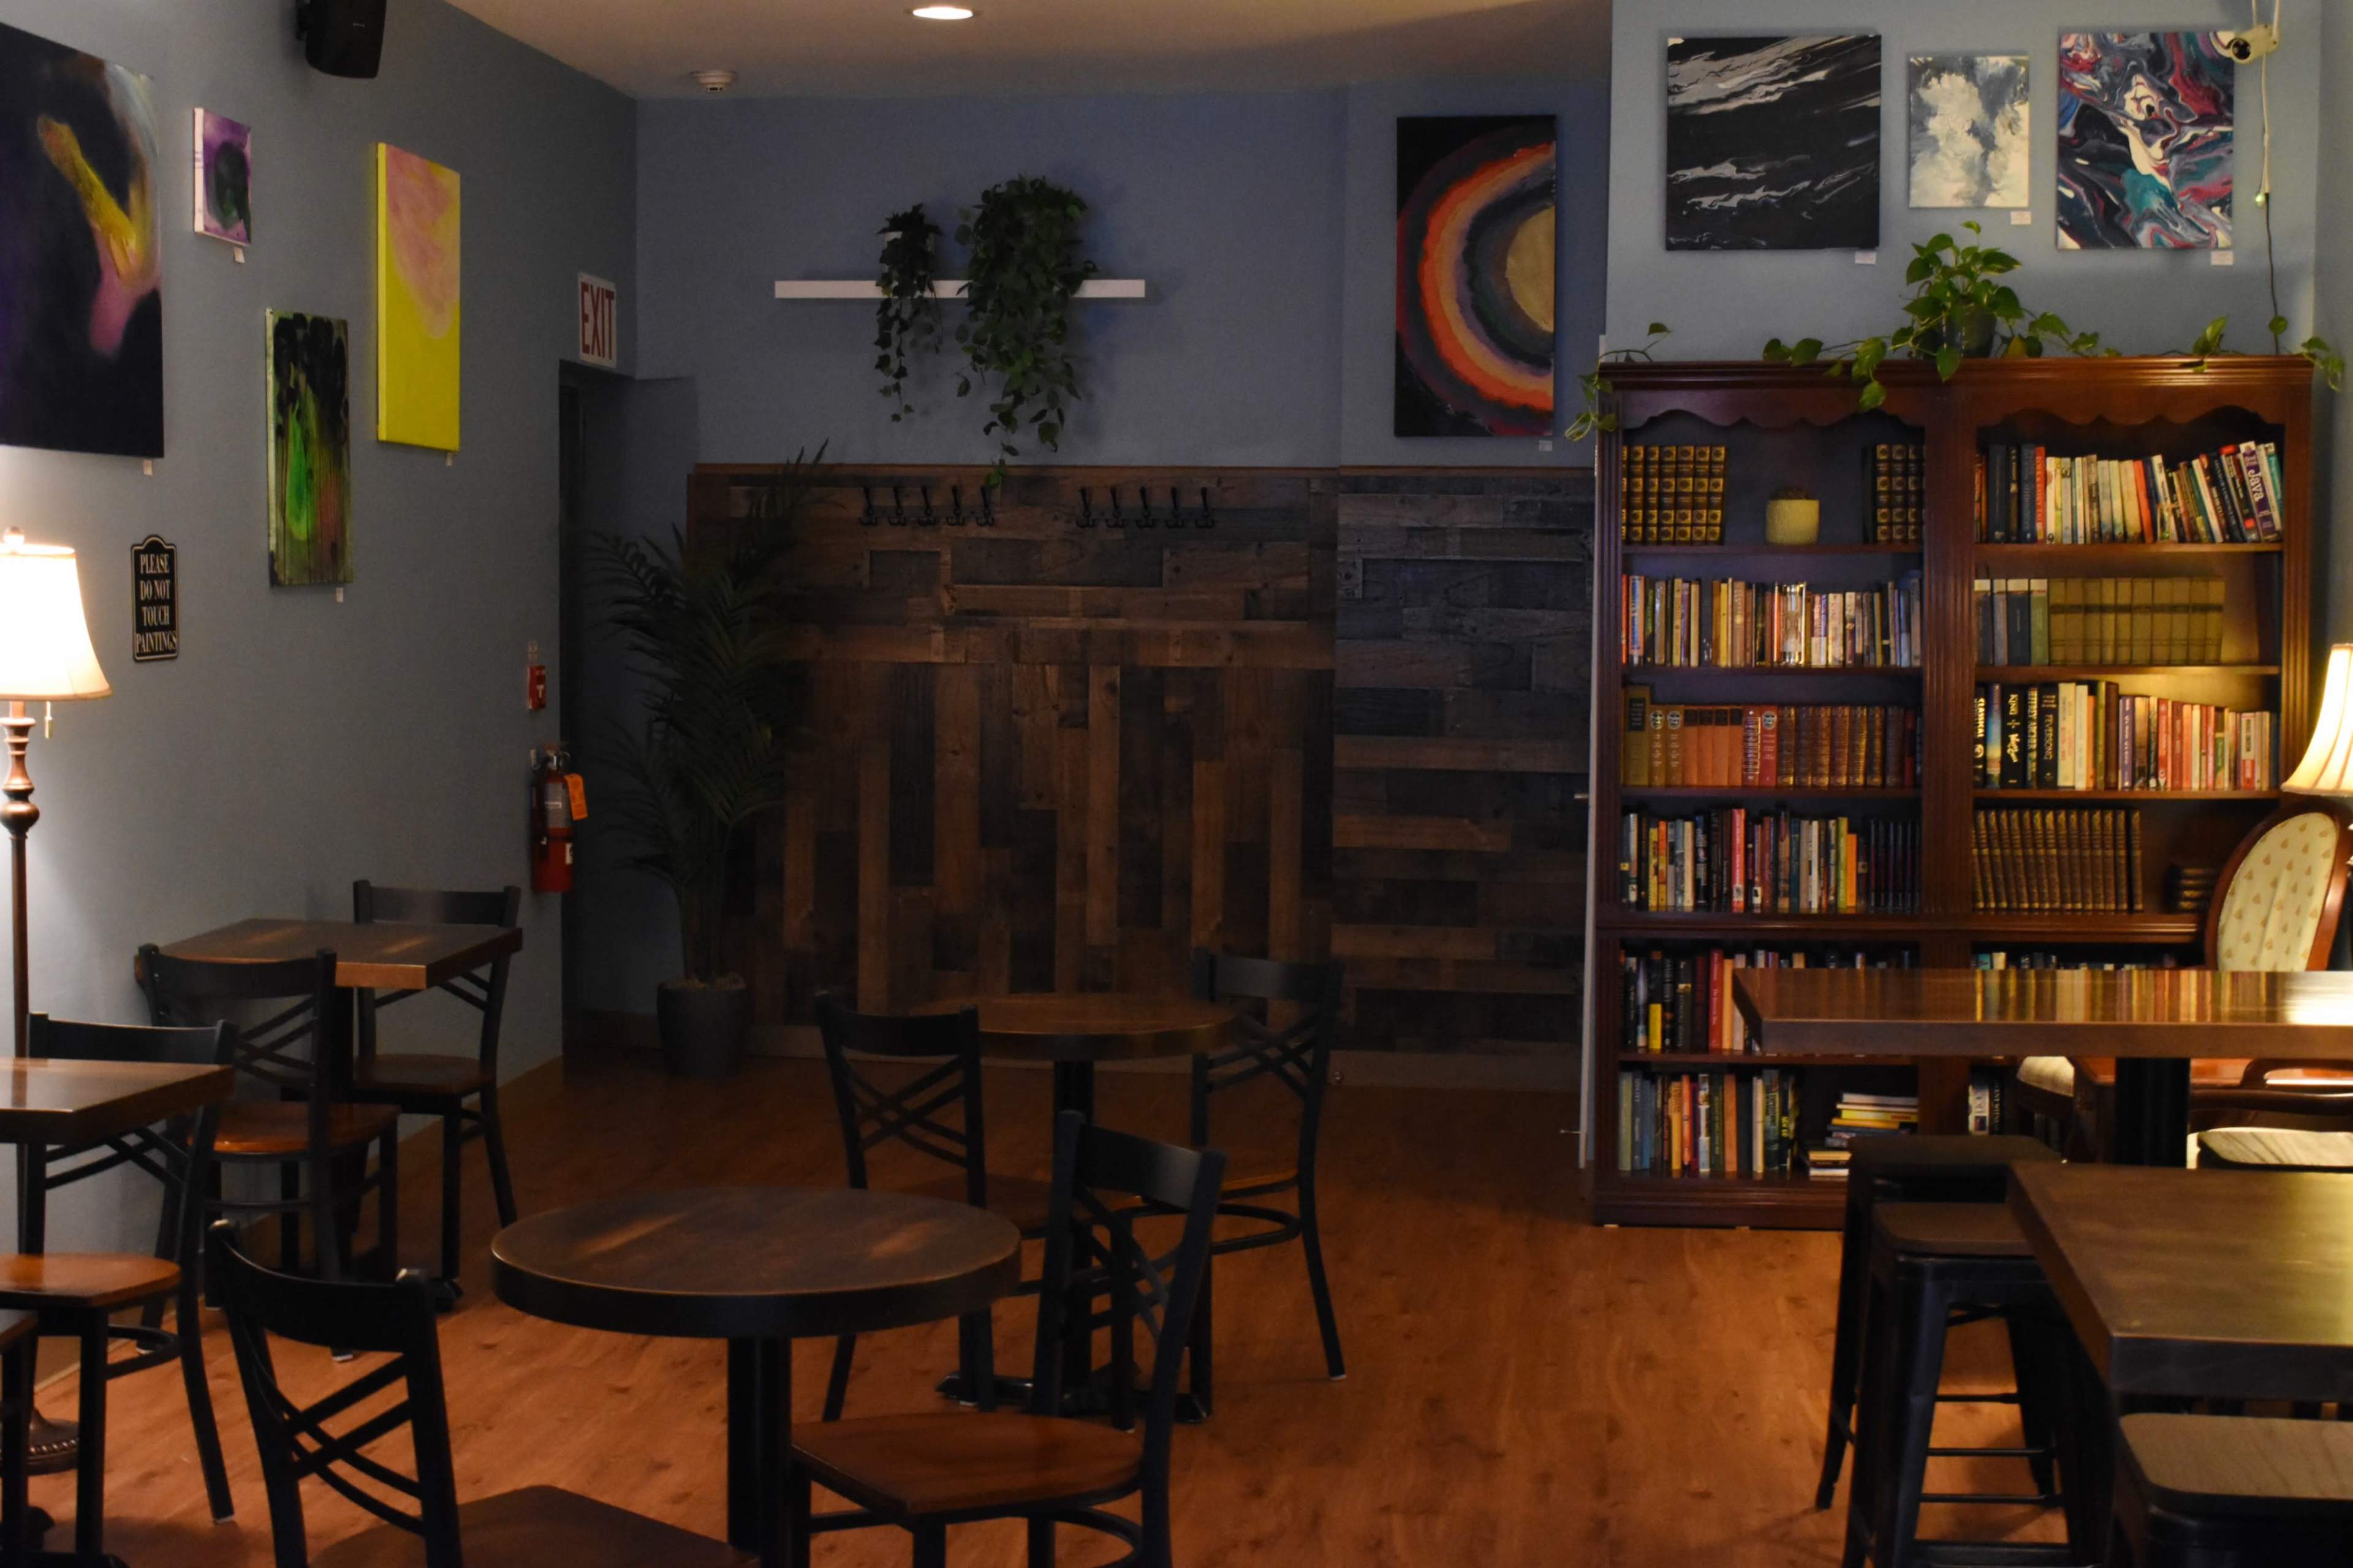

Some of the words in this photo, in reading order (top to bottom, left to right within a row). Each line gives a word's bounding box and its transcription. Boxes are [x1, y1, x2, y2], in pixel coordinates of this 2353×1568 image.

[581, 282, 614, 360] EXIT
[2248, 469, 2264, 502] Java
[140, 554, 169, 574] PLEASE
[140, 580, 153, 601] DO
[154, 579, 170, 600] NOT
[142, 605, 170, 627] TOUCH
[137, 631, 177, 654] PAINTINGS
[2008, 694, 2019, 716] KING
[2028, 721, 2038, 750] ARCHER
[2044, 714, 2054, 760] FEVERSONG
